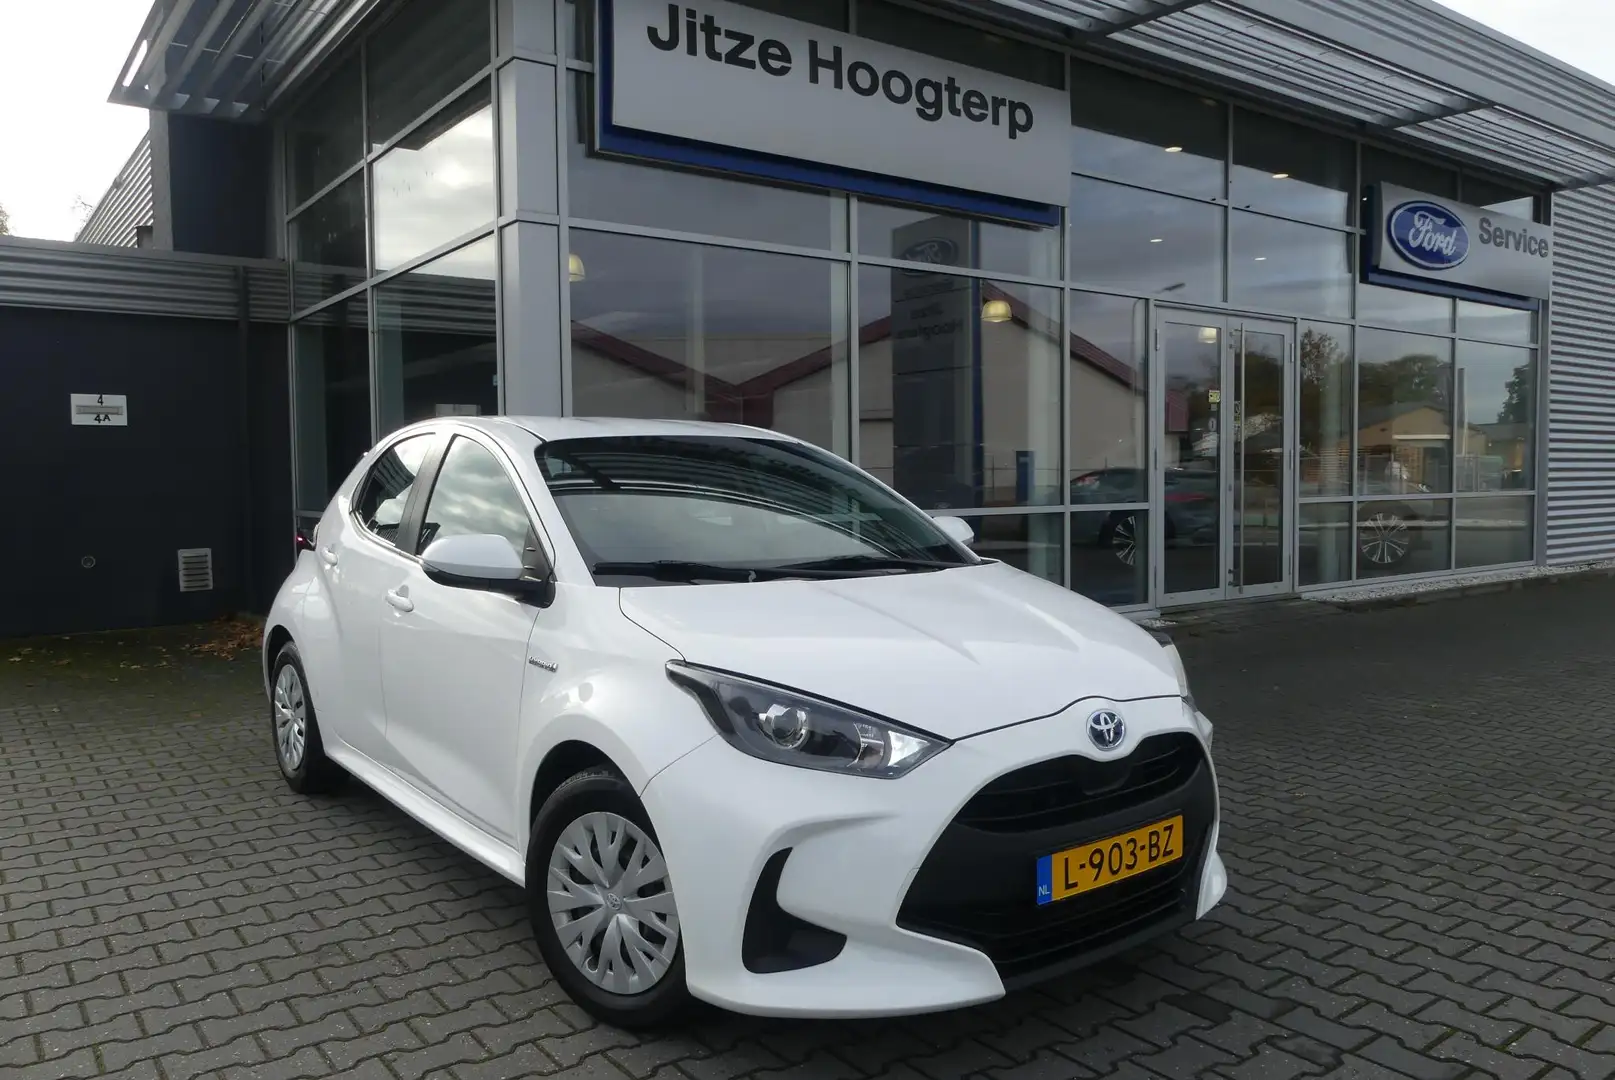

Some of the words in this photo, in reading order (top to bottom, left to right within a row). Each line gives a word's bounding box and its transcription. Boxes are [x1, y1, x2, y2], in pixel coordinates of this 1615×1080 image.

[647, 4, 792, 77] Jitze
[808, 39, 1034, 139] Hoogterp
[1409, 211, 1458, 256] Ford
[1478, 217, 1548, 258] Service
[97, 394, 104, 406] 4
[94, 413, 111, 424] 4A
[1064, 824, 1174, 890] L-903-BZ
[1038, 885, 1051, 896] NL
